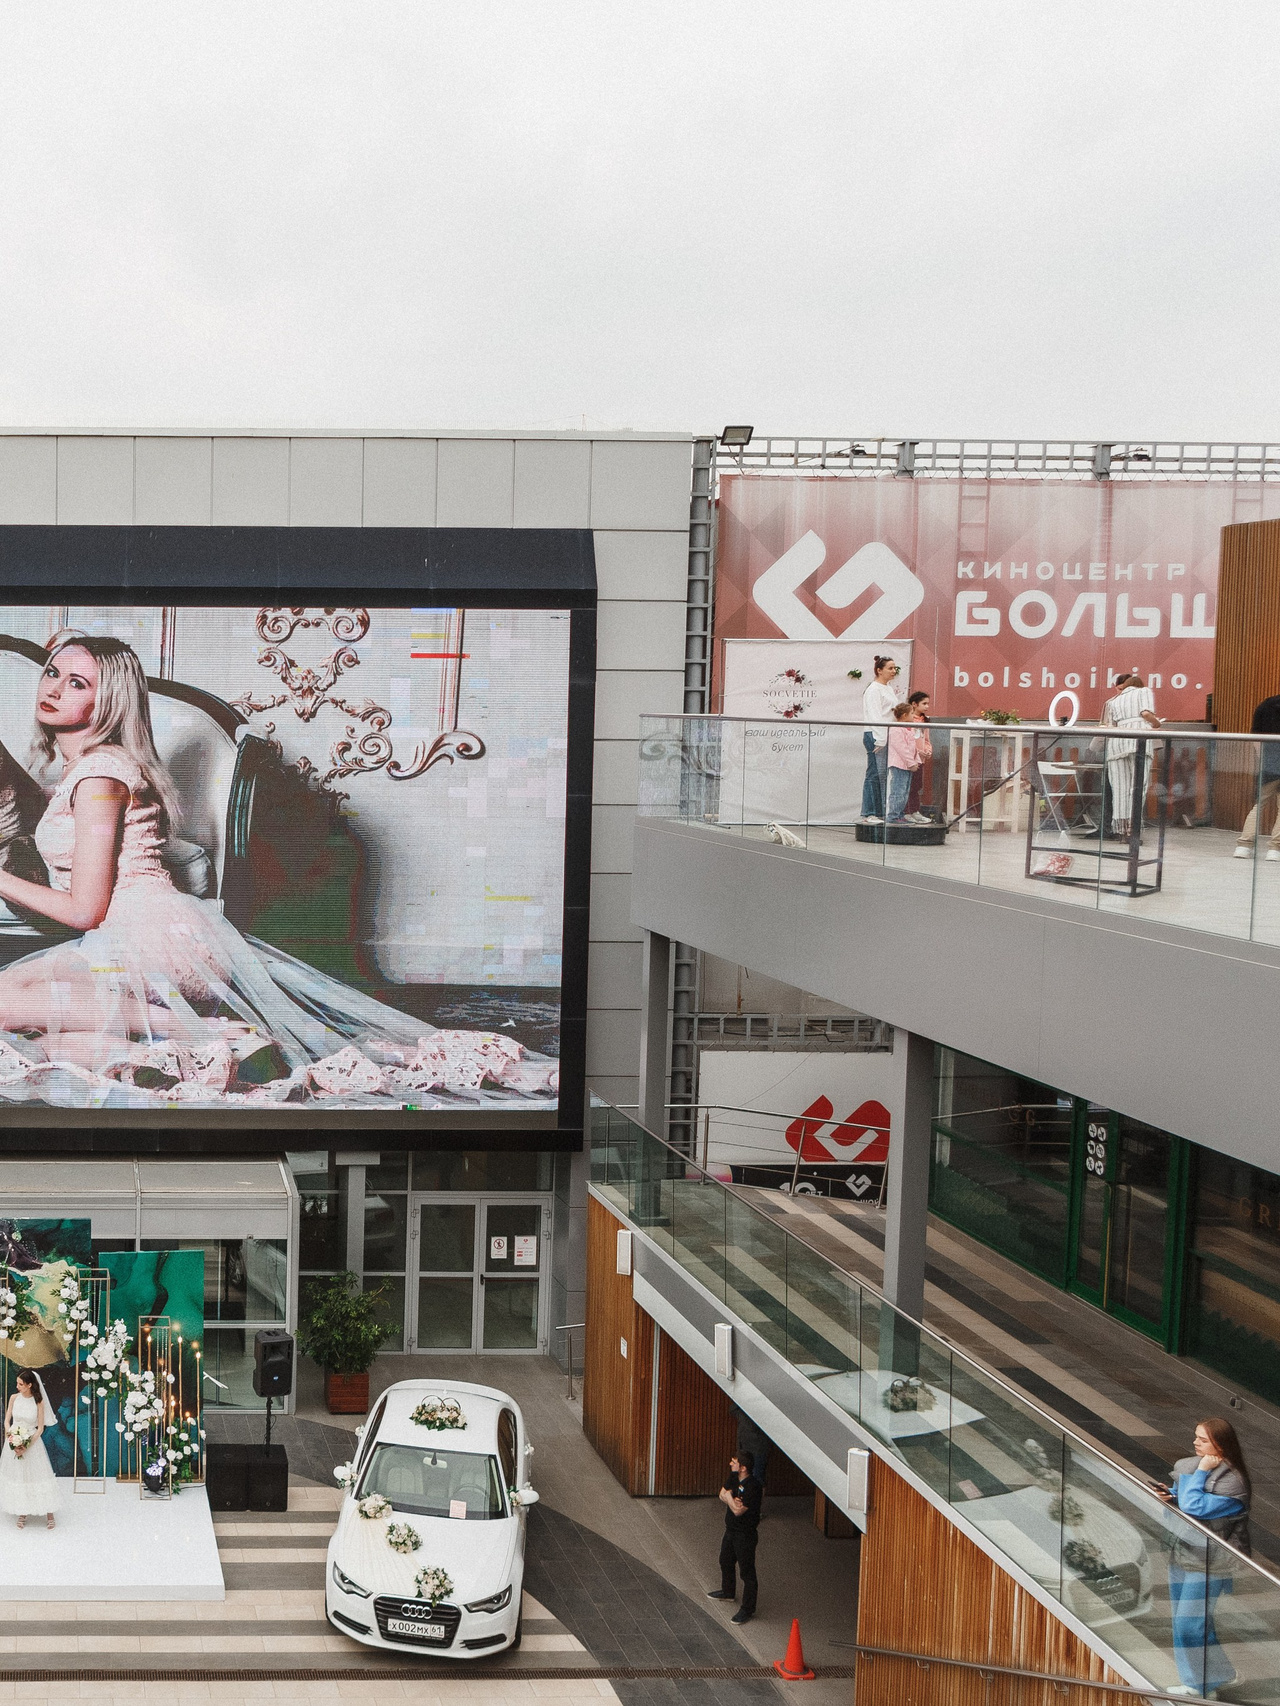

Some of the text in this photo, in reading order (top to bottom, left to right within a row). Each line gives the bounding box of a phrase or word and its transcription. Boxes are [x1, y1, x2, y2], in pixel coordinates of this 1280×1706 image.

[957, 561, 1186, 581] КИНОЦЕНТР
[762, 689, 817, 698] SOCVETIE
[771, 743, 803, 753] букет
